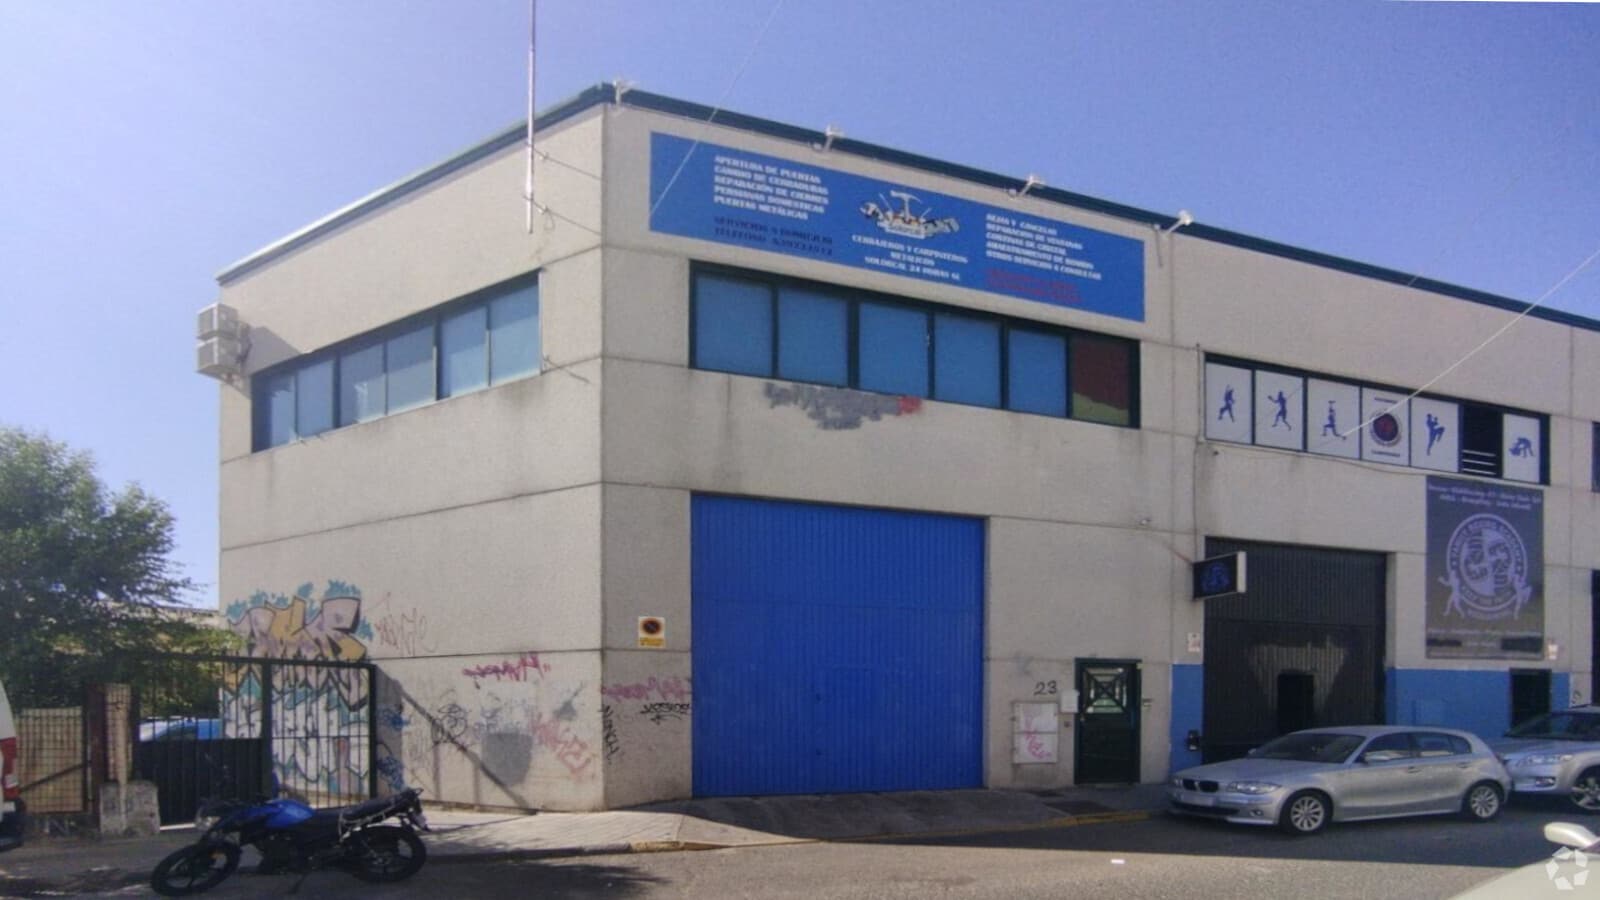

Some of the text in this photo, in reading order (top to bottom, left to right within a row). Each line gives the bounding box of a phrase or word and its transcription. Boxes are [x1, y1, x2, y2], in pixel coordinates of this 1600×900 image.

[714, 155, 821, 184] APERTURA DE PUERTAS
[714, 165, 829, 195] CAMBIO DE CERRADURAS
[714, 185, 765, 202] PERSIANAS
[776, 187, 787, 196] DE
[714, 195, 756, 210] PUERTAS
[1025, 240, 1035, 248] DE
[1035, 233, 1045, 242] DE
[986, 250, 1012, 262] OTROS
[1060, 264, 1102, 279] CONSULTAR
[1053, 254, 1063, 263] DE
[1034, 680, 1057, 695] 23
